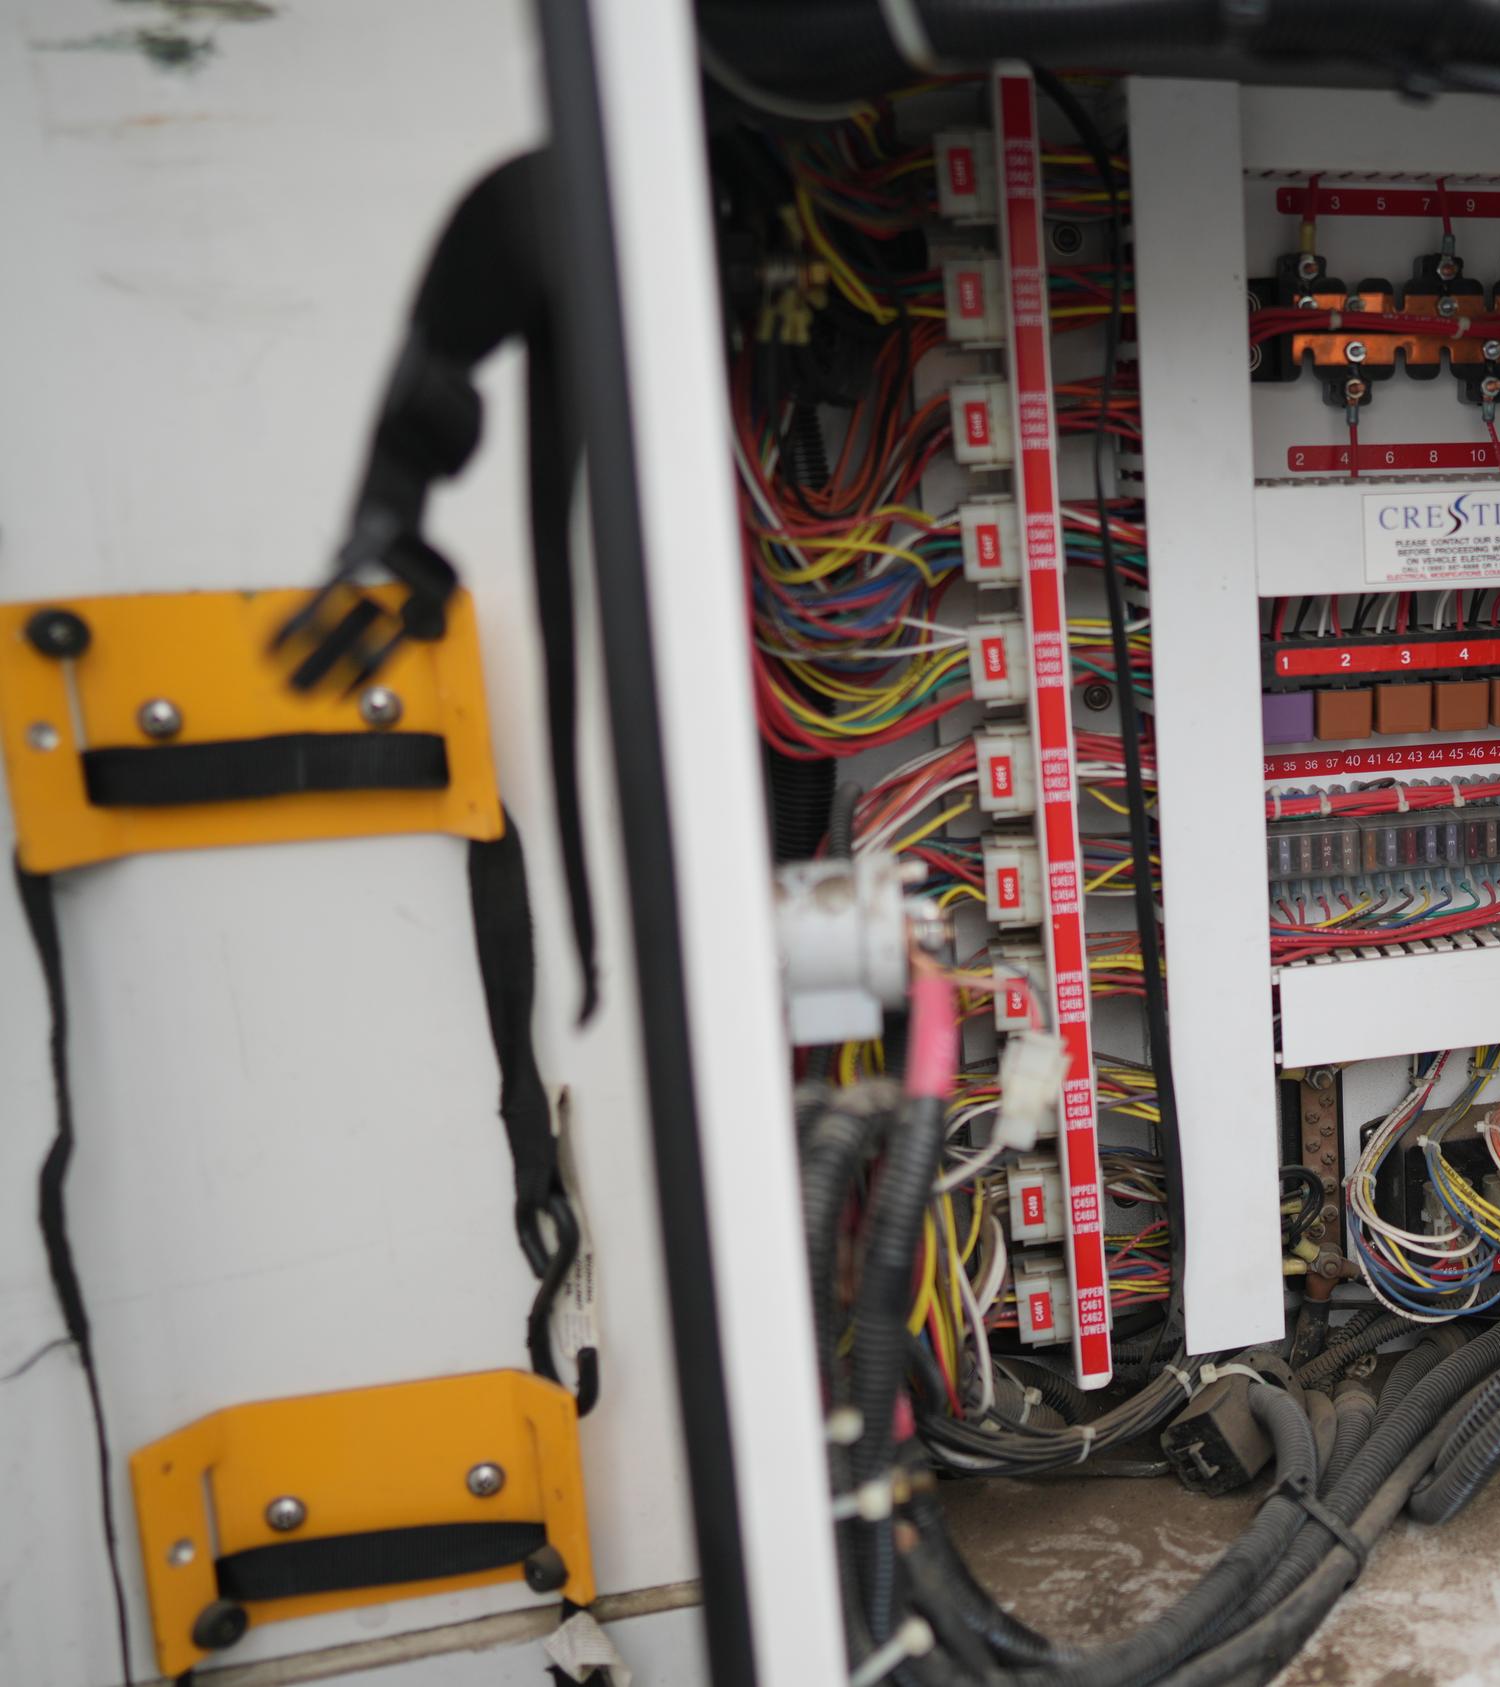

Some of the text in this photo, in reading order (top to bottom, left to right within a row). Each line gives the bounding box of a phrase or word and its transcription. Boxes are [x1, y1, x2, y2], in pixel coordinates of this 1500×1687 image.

[1285, 195, 1291, 208] 1
[1330, 195, 1340, 209] 3
[1376, 196, 1385, 210] 5
[1421, 197, 1430, 210] 7
[1466, 198, 1475, 212] 9
[1295, 452, 1304, 465] 2
[1340, 452, 1348, 464] 4
[1385, 450, 1394, 463] 6
[1429, 449, 1437, 462] 8
[1470, 449, 1485, 461] 10
[1026, 513, 1053, 525] UPPER
[1395, 538, 1427, 547] PLEASE
[1431, 537, 1469, 546] CONTACT
[1473, 536, 1491, 544] OUR
[1398, 547, 1430, 556] BEFORE
[1434, 545, 1489, 554] PROCEEDING
[1030, 557, 1057, 570] LOWER
[1406, 557, 1419, 565] ON
[1422, 555, 1457, 564] VEHICLE
[1386, 572, 1427, 581] ELECTRICAL
[1430, 570, 1482, 578] MODIFICATIONS
[1034, 631, 1061, 644] UPPER
[1282, 656, 1288, 669] 1
[1340, 653, 1350, 666] 2
[1400, 650, 1410, 664] 3
[1459, 647, 1469, 660] 4
[1038, 675, 1064, 688] LOWER
[1041, 748, 1068, 760] UPPER
[1283, 761, 1296, 771] 35
[1304, 759, 1318, 769] 36
[1326, 758, 1338, 768] 37
[1345, 754, 1360, 766] 40
[1367, 753, 1380, 764] 41
[1386, 751, 1402, 763] 42
[1407, 750, 1422, 762] 43
[1427, 749, 1443, 760] 44
[1448, 747, 1463, 759] 45
[1468, 746, 1484, 758] 46
[1045, 790, 1071, 803] LOWER
[1049, 860, 1075, 873] UPPER
[1052, 902, 1078, 915] LOWER
[1056, 970, 1082, 983] UPPER
[1012, 991, 1023, 1010] C45
[1059, 1010, 1086, 1024] LOWER
[1064, 1078, 1090, 1092] UPPER
[1066, 1117, 1093, 1131] LOWER
[1070, 1183, 1097, 1197] UPPER
[1072, 1222, 1100, 1235] LOWER
[1077, 1286, 1104, 1299] UPPER
[1034, 1300, 1044, 1322] C461
[1080, 1299, 1102, 1312] C461
[1081, 1311, 1104, 1324] C462
[1079, 1323, 1107, 1337] LOWER
